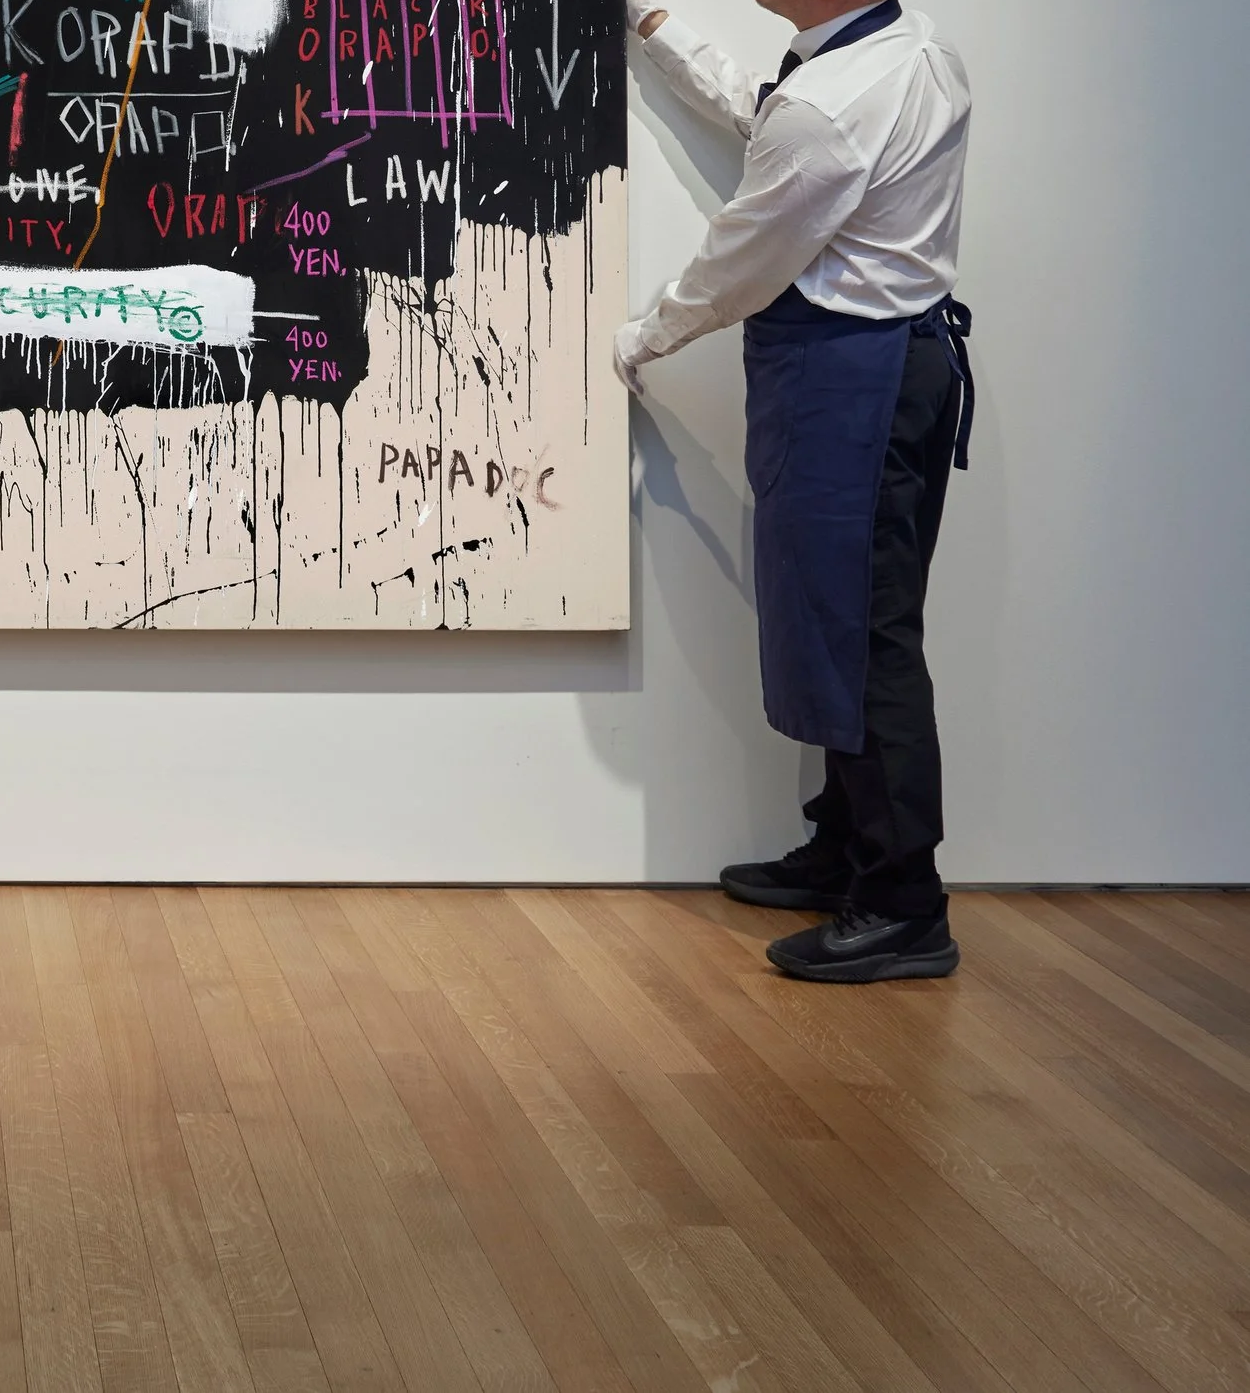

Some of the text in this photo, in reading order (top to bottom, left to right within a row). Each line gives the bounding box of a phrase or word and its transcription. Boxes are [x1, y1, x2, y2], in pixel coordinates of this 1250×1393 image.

[294, 82, 316, 137] K
[345, 153, 451, 207] LAW
[146, 181, 282, 245] ORAP
[284, 200, 331, 239] 400
[285, 324, 329, 353] 400
[378, 441, 475, 491] PAPA
